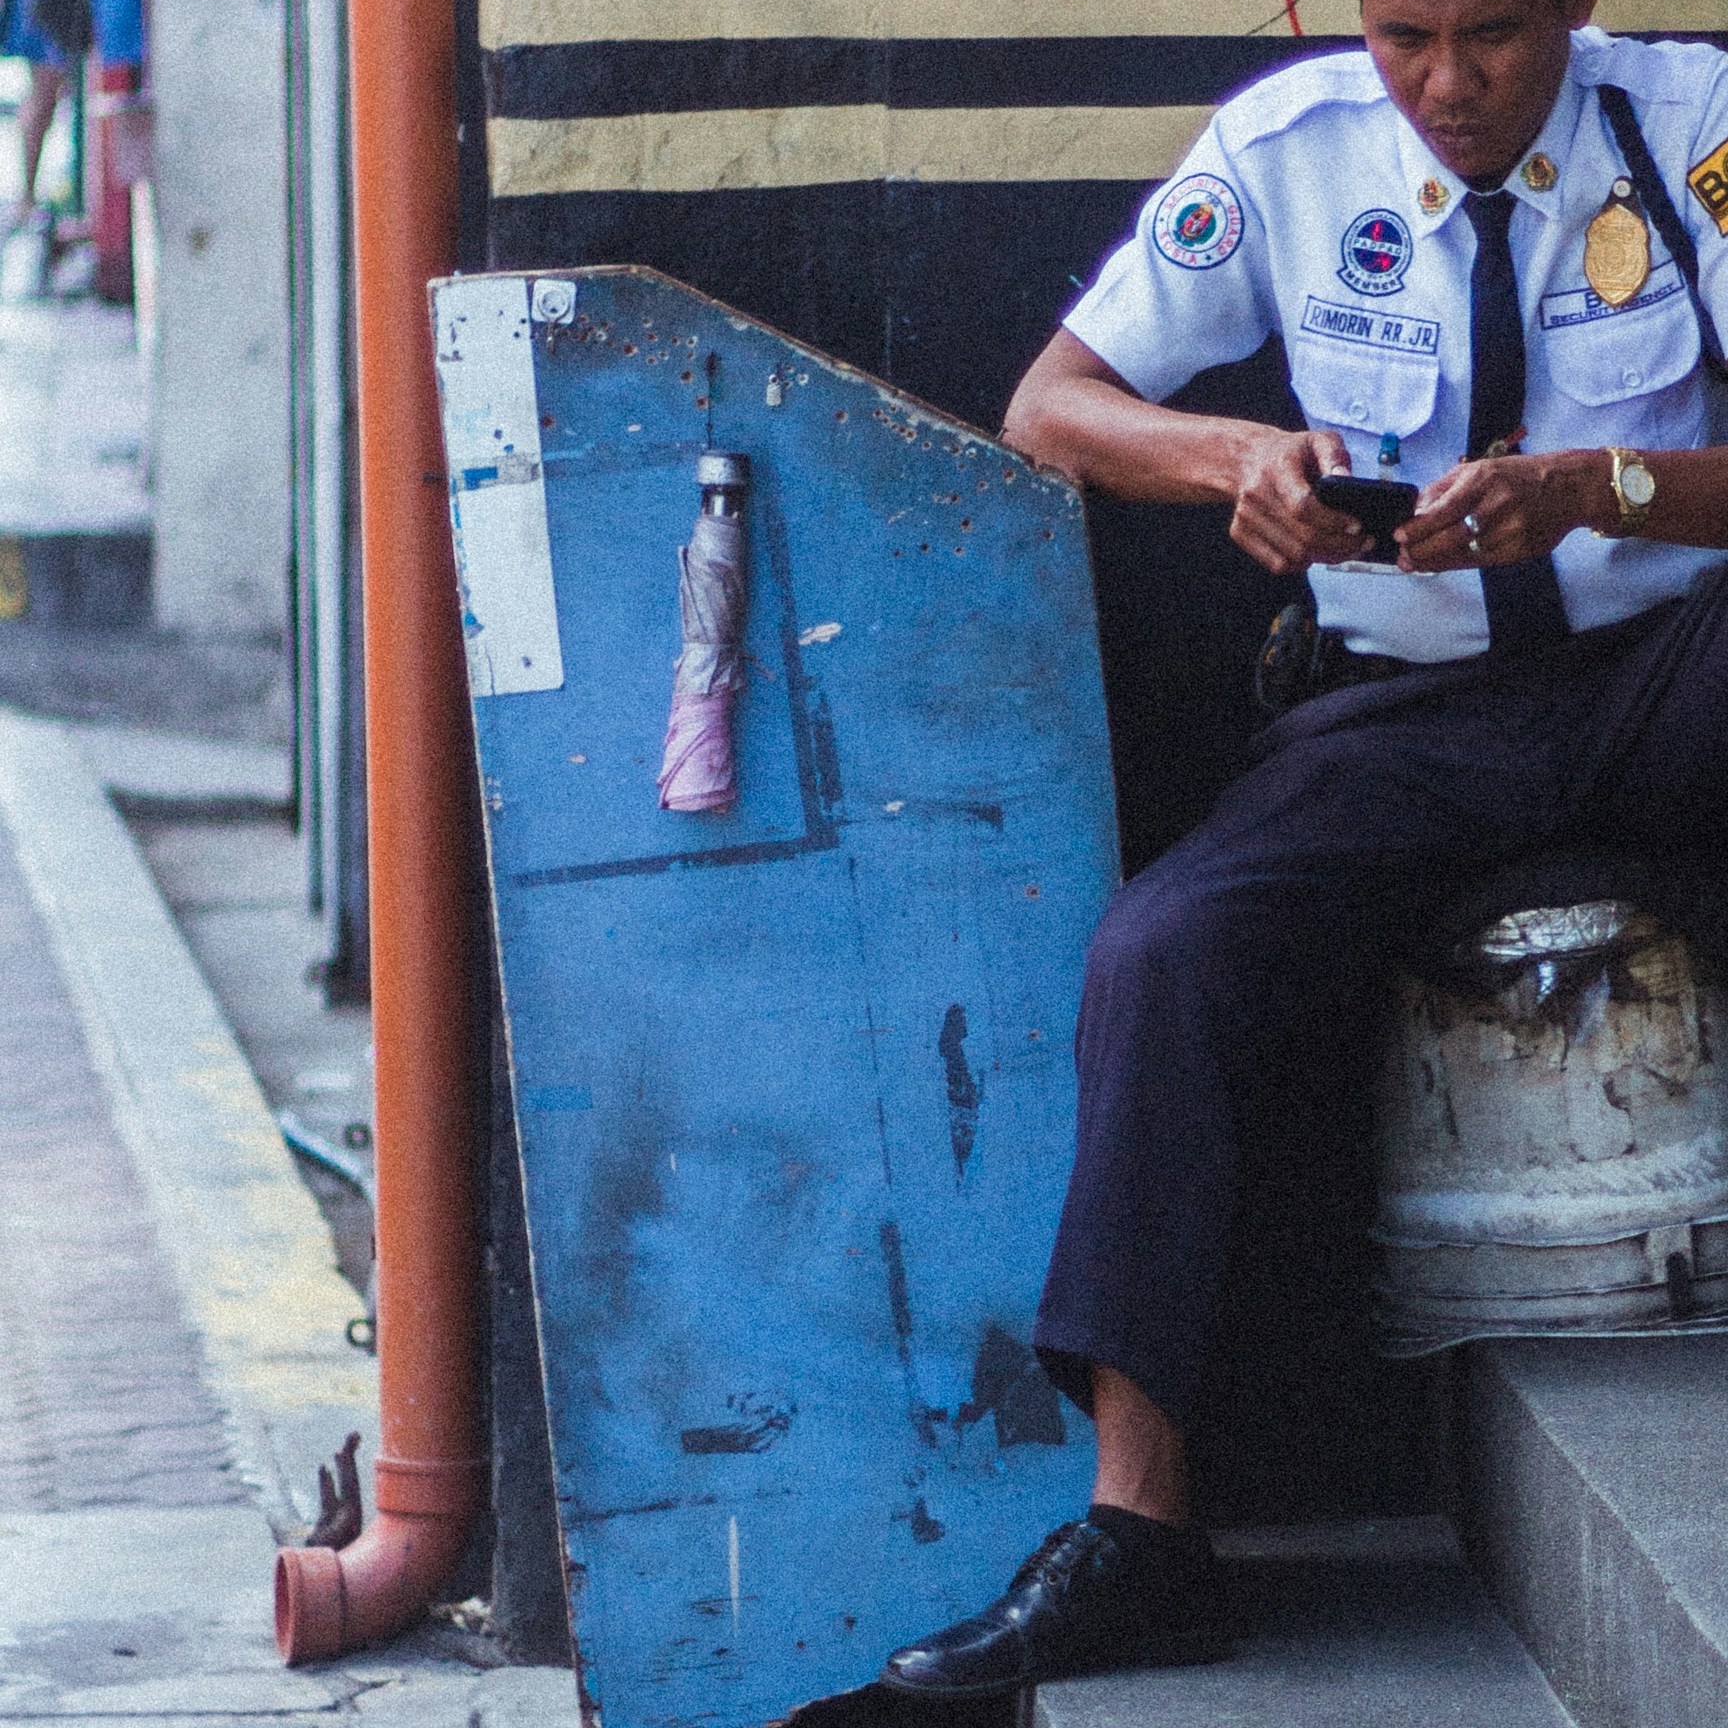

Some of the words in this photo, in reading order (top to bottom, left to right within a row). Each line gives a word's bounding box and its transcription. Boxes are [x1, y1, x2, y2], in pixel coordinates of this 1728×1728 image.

[1217, 204, 1242, 256] GUARD
[1345, 269, 1397, 291] MEMBER
[1309, 305, 1374, 338] RIMORIN
